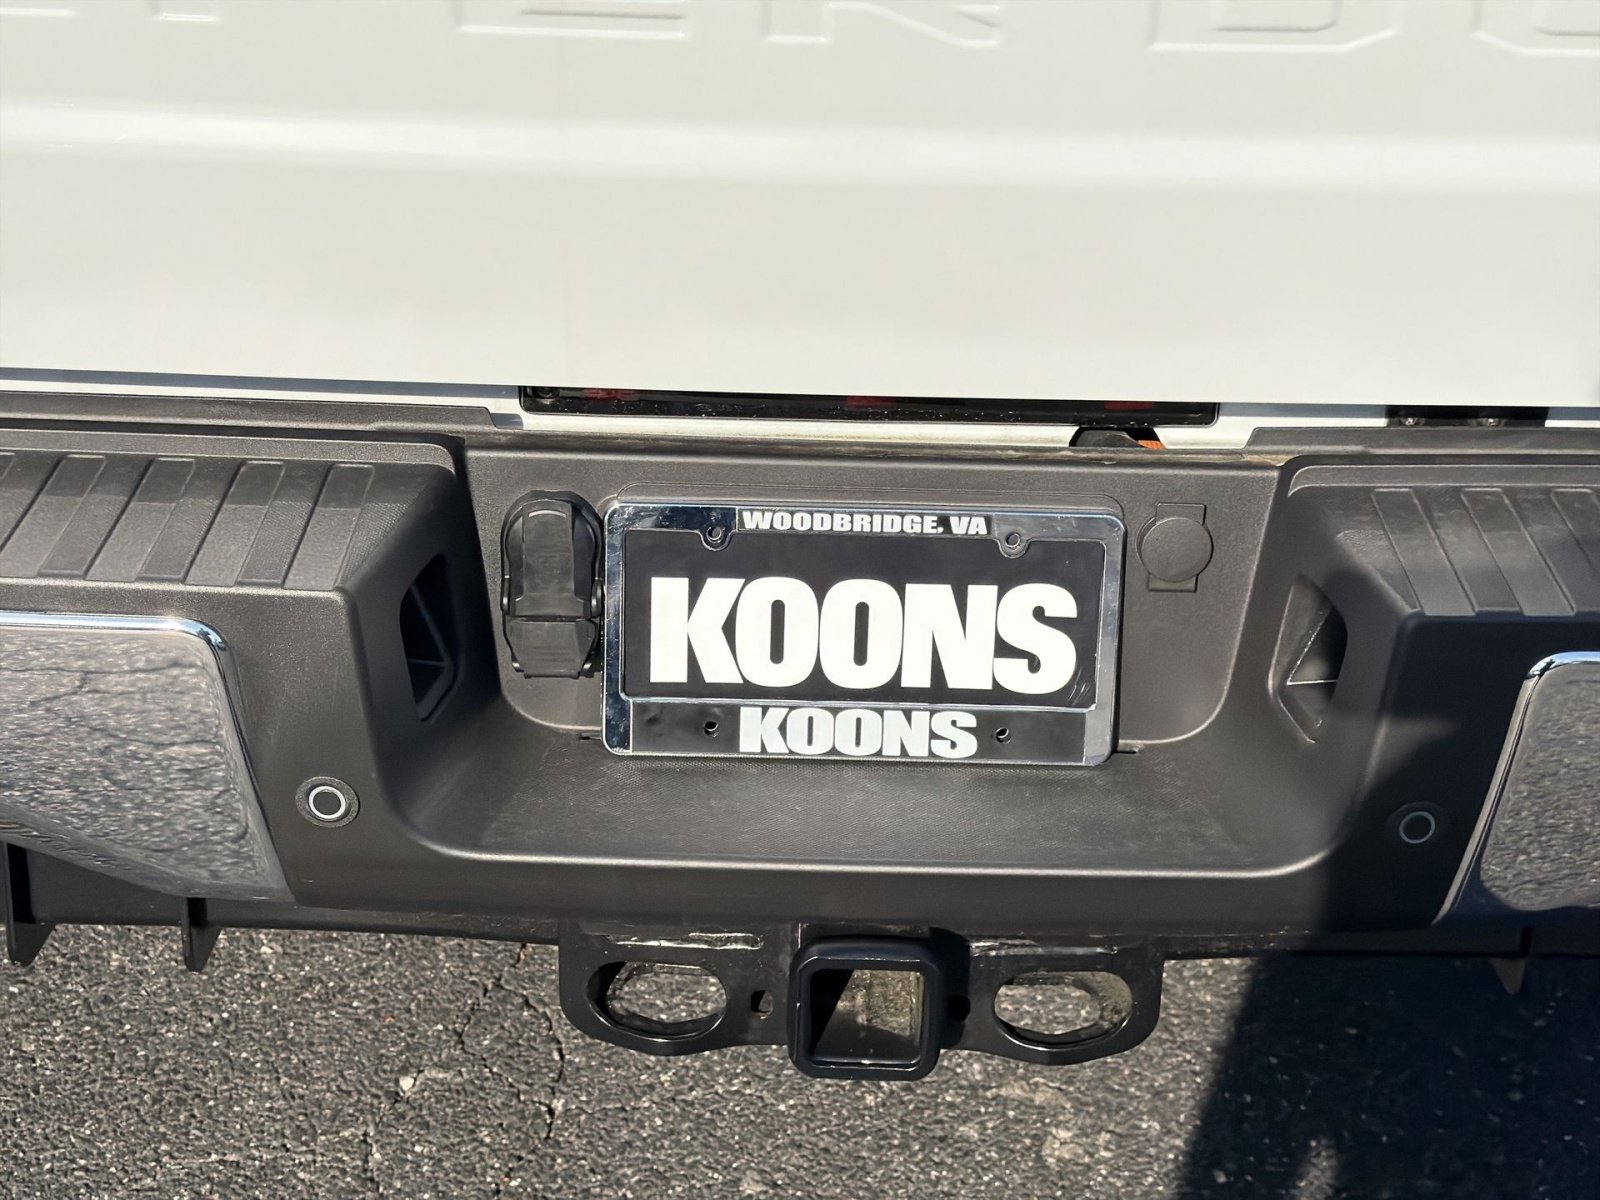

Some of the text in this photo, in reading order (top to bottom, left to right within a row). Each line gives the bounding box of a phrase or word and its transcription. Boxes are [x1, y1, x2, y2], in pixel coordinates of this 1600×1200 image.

[742, 511, 988, 535] WOODBRIDGE, VA
[650, 576, 1078, 694] KOONS
[739, 706, 978, 759] KOONS
